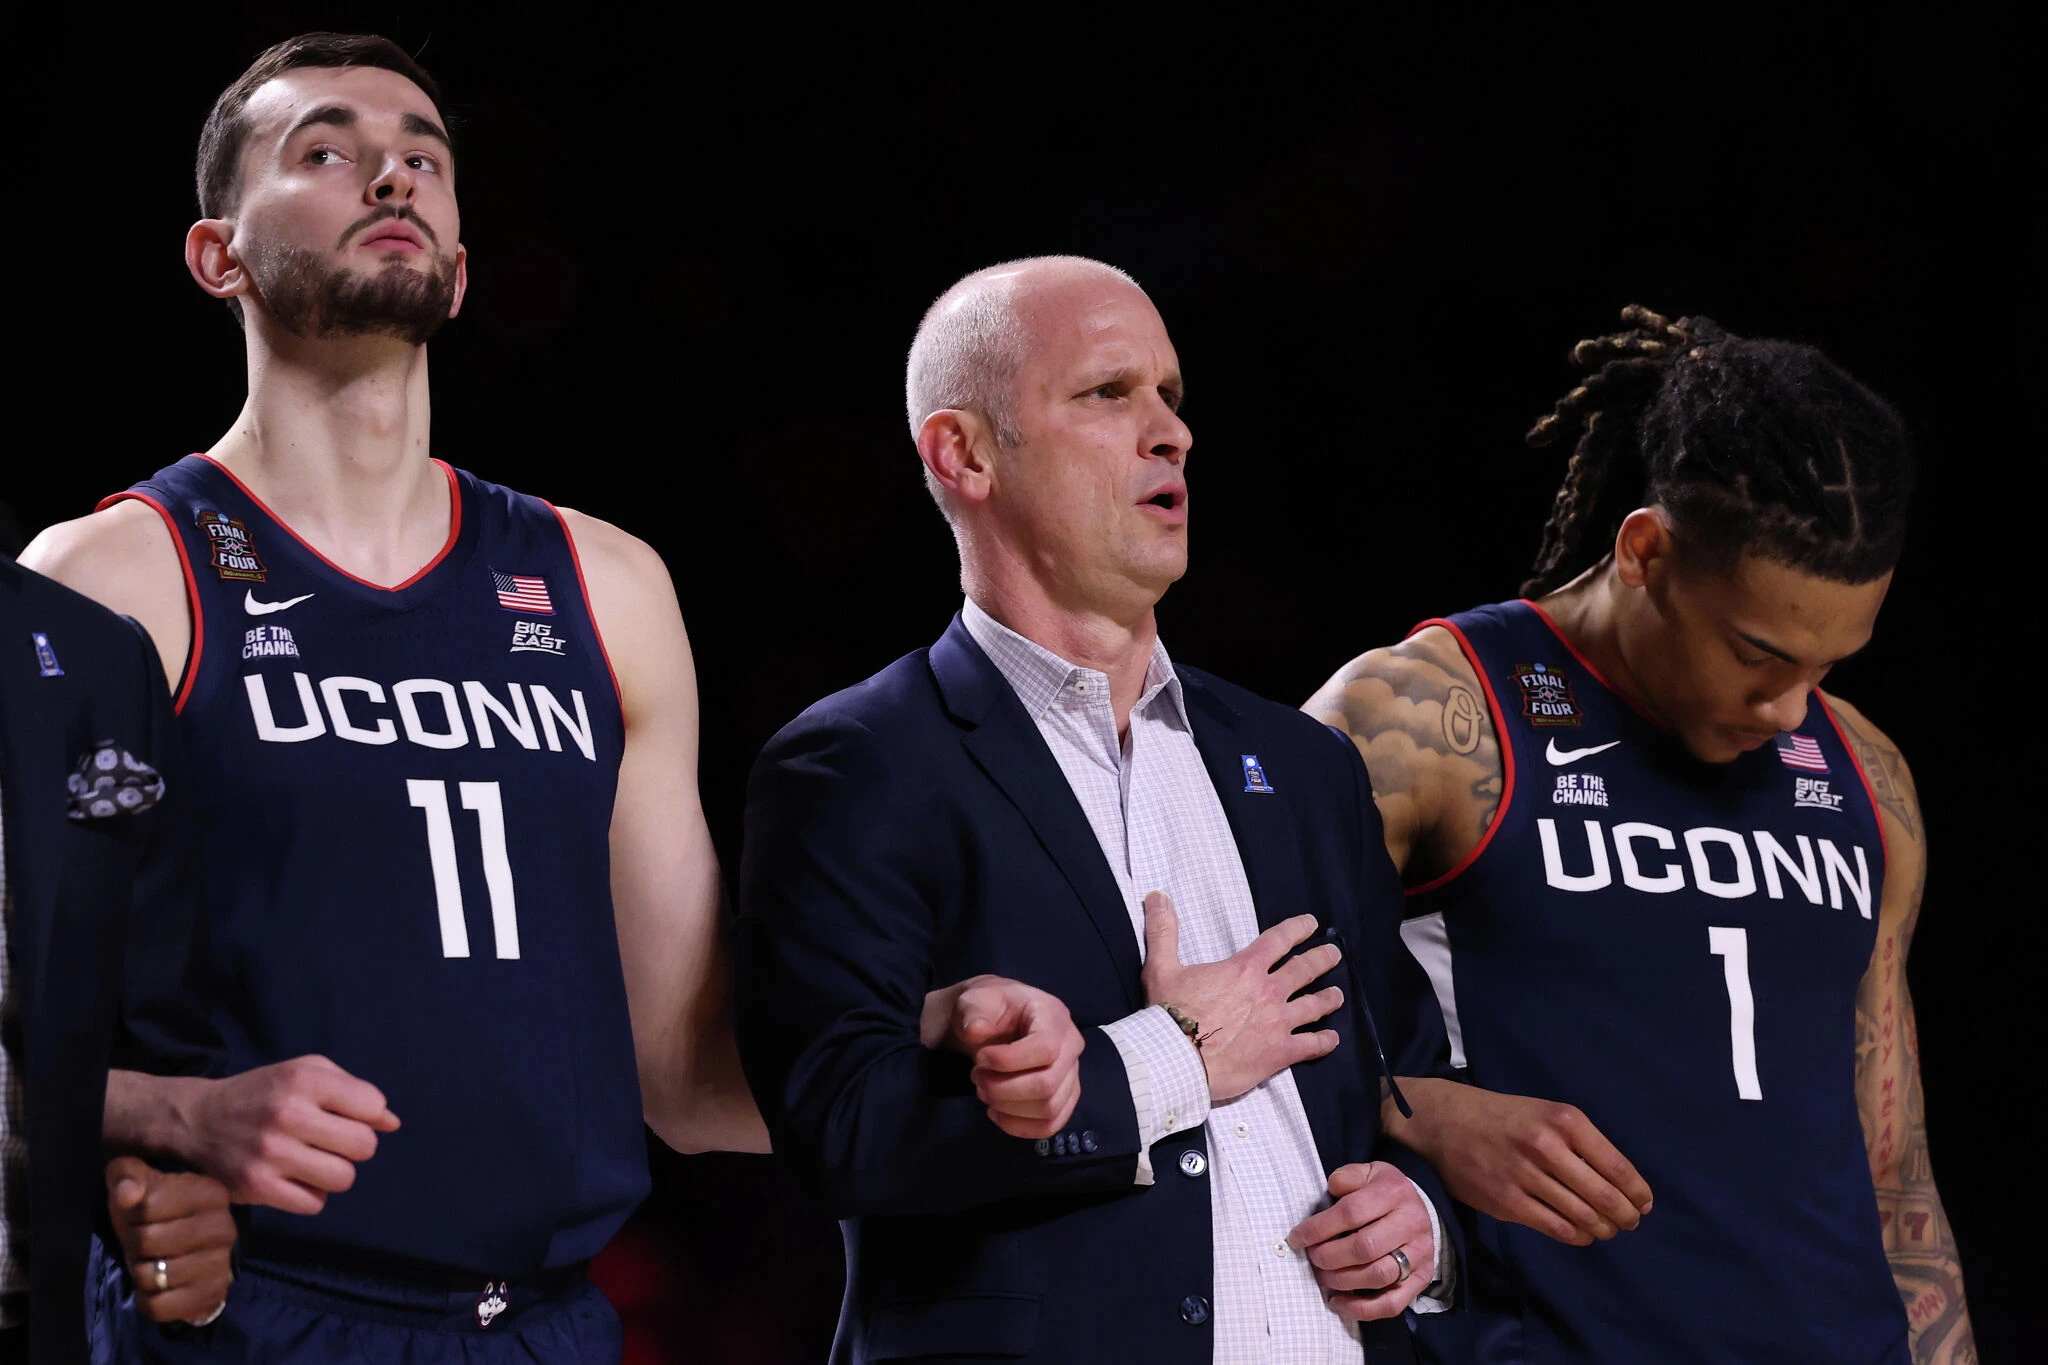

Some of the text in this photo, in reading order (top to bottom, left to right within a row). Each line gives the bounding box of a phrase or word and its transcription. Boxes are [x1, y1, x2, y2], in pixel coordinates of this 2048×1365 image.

[207, 524, 248, 542] FINAL
[219, 552, 259, 570] FOUR
[245, 627, 266, 644] BE
[514, 620, 552, 635] BIG
[512, 632, 566, 650] EAST
[1520, 673, 1566, 689] FINAL
[244, 672, 596, 761] UCONN
[1532, 702, 1574, 716] FOUR
[1556, 774, 1605, 791] BE THE
[1795, 777, 1829, 793] BIG
[1552, 789, 1609, 807] CHANGE
[1795, 789, 1843, 806] EAST
[406, 778, 520, 959] 11
[1536, 818, 1872, 920] UCONN
[1708, 926, 1763, 1101] 1
[1904, 1211, 1929, 1241] 7
